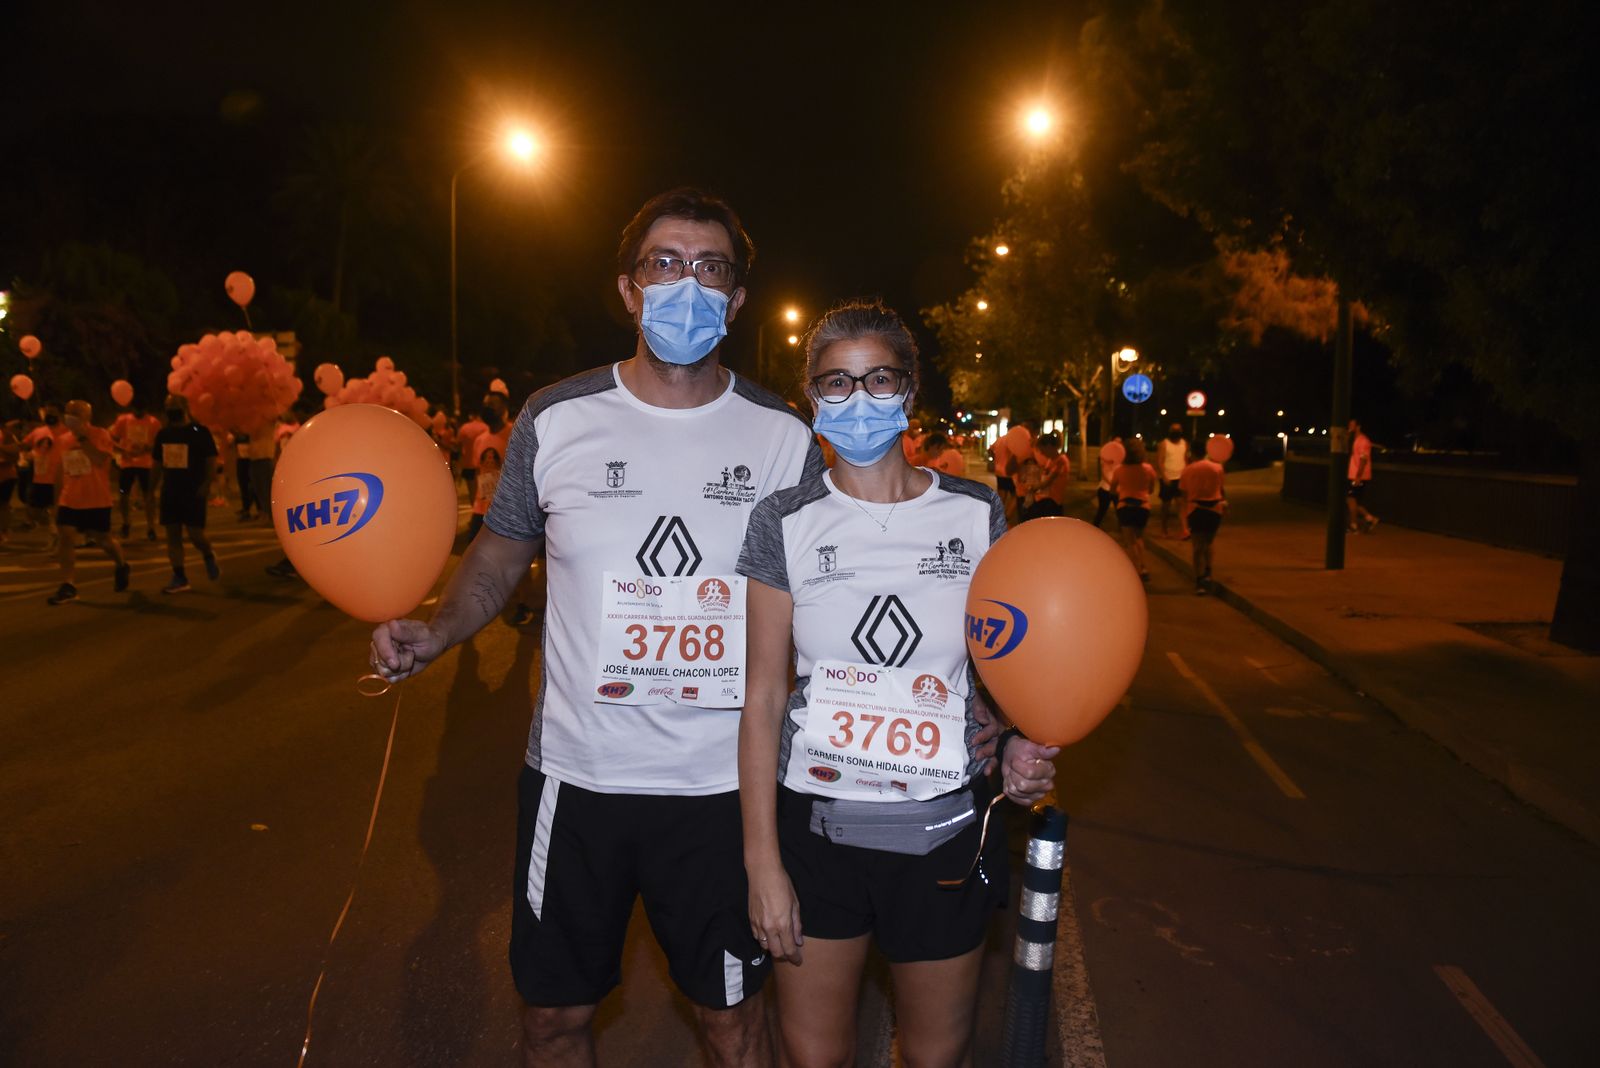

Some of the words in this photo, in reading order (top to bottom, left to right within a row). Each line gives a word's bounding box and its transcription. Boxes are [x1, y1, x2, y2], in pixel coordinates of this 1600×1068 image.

[623, 624, 724, 661] 3768
[603, 664, 628, 674] JOSÉ
[631, 666, 670, 676] MANUEL
[673, 668, 710, 677] CHACON
[713, 667, 739, 677] LOPEZ
[831, 699, 856, 708] CARRERA
[857, 703, 887, 712] NOCTURNA
[899, 707, 939, 718] GUADALQUIVIR
[828, 710, 941, 760] 3769
[807, 748, 844, 763] CARMEN
[846, 757, 874, 768] SONIA
[876, 761, 917, 775] HIDALGO
[919, 766, 960, 780] JIMENEZ
